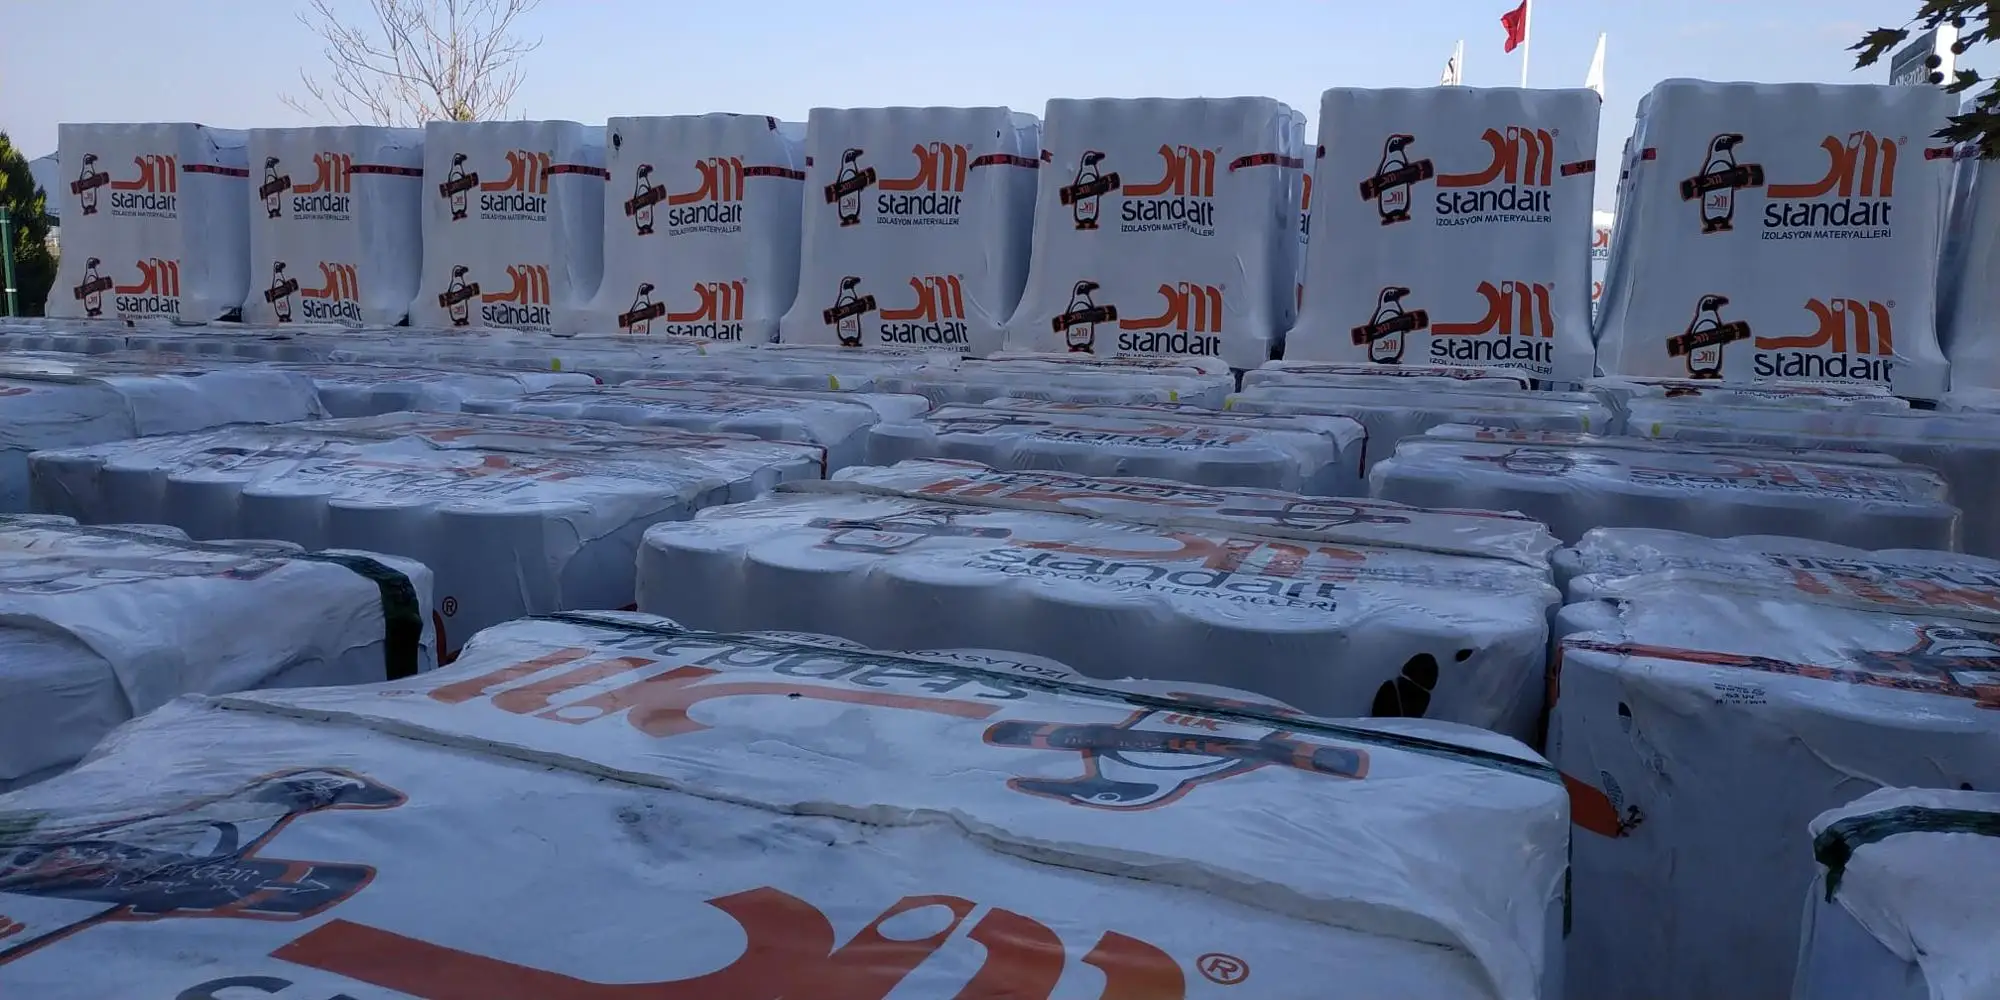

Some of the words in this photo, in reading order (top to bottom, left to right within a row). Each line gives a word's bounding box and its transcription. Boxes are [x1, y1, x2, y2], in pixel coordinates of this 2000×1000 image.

[111, 192, 176, 210] standart
[293, 192, 350, 213] standart
[480, 192, 547, 213] standart
[877, 192, 962, 215] standart
[1121, 196, 1214, 226] standart
[1435, 185, 1552, 215] standart
[669, 201, 744, 227] standart
[1763, 198, 1893, 228] standart
[116, 295, 180, 314] standart
[302, 299, 362, 322] standart
[481, 303, 552, 325] standart
[666, 321, 744, 341] standart
[880, 321, 969, 344] standart
[1118, 331, 1221, 356] standart
[1430, 336, 1553, 363] standart
[1753, 352, 1895, 382] standart
[980, 549, 1347, 600] standart
